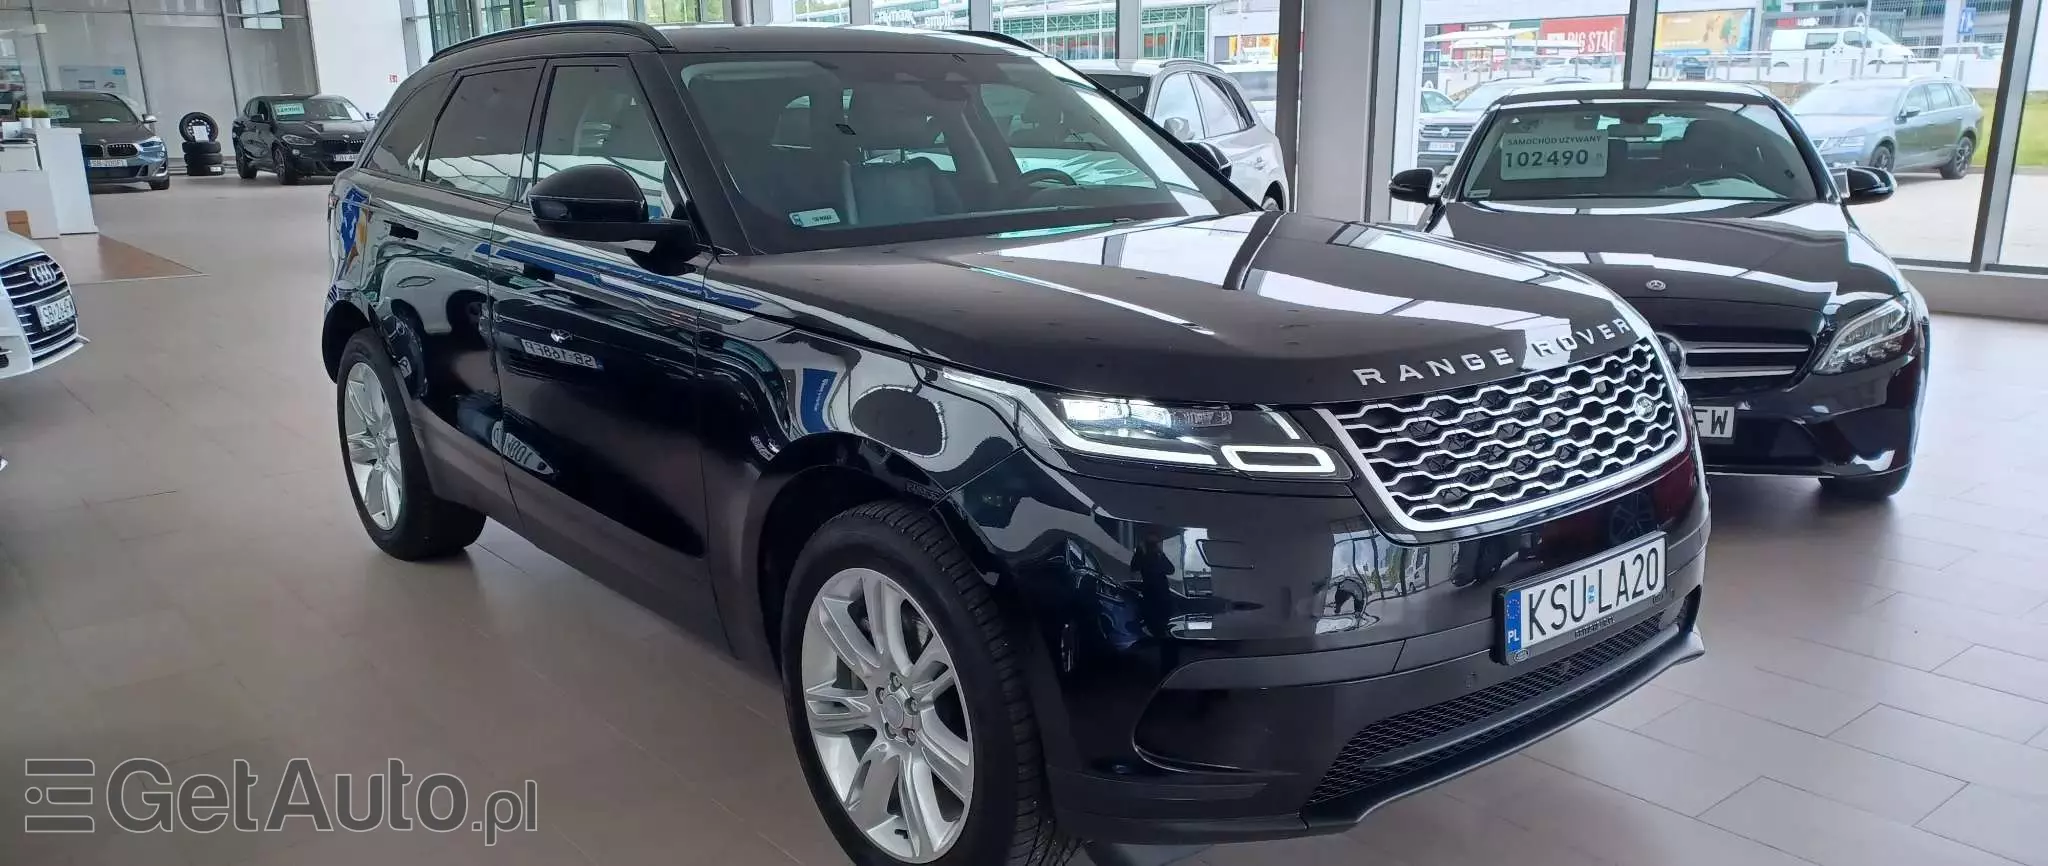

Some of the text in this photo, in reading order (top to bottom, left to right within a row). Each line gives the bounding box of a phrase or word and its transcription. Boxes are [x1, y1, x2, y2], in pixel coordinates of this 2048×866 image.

[1352, 318, 1630, 386] RANGE ROVER
[1528, 547, 1659, 641] KSU LA20
[1507, 629, 1520, 643] PL
